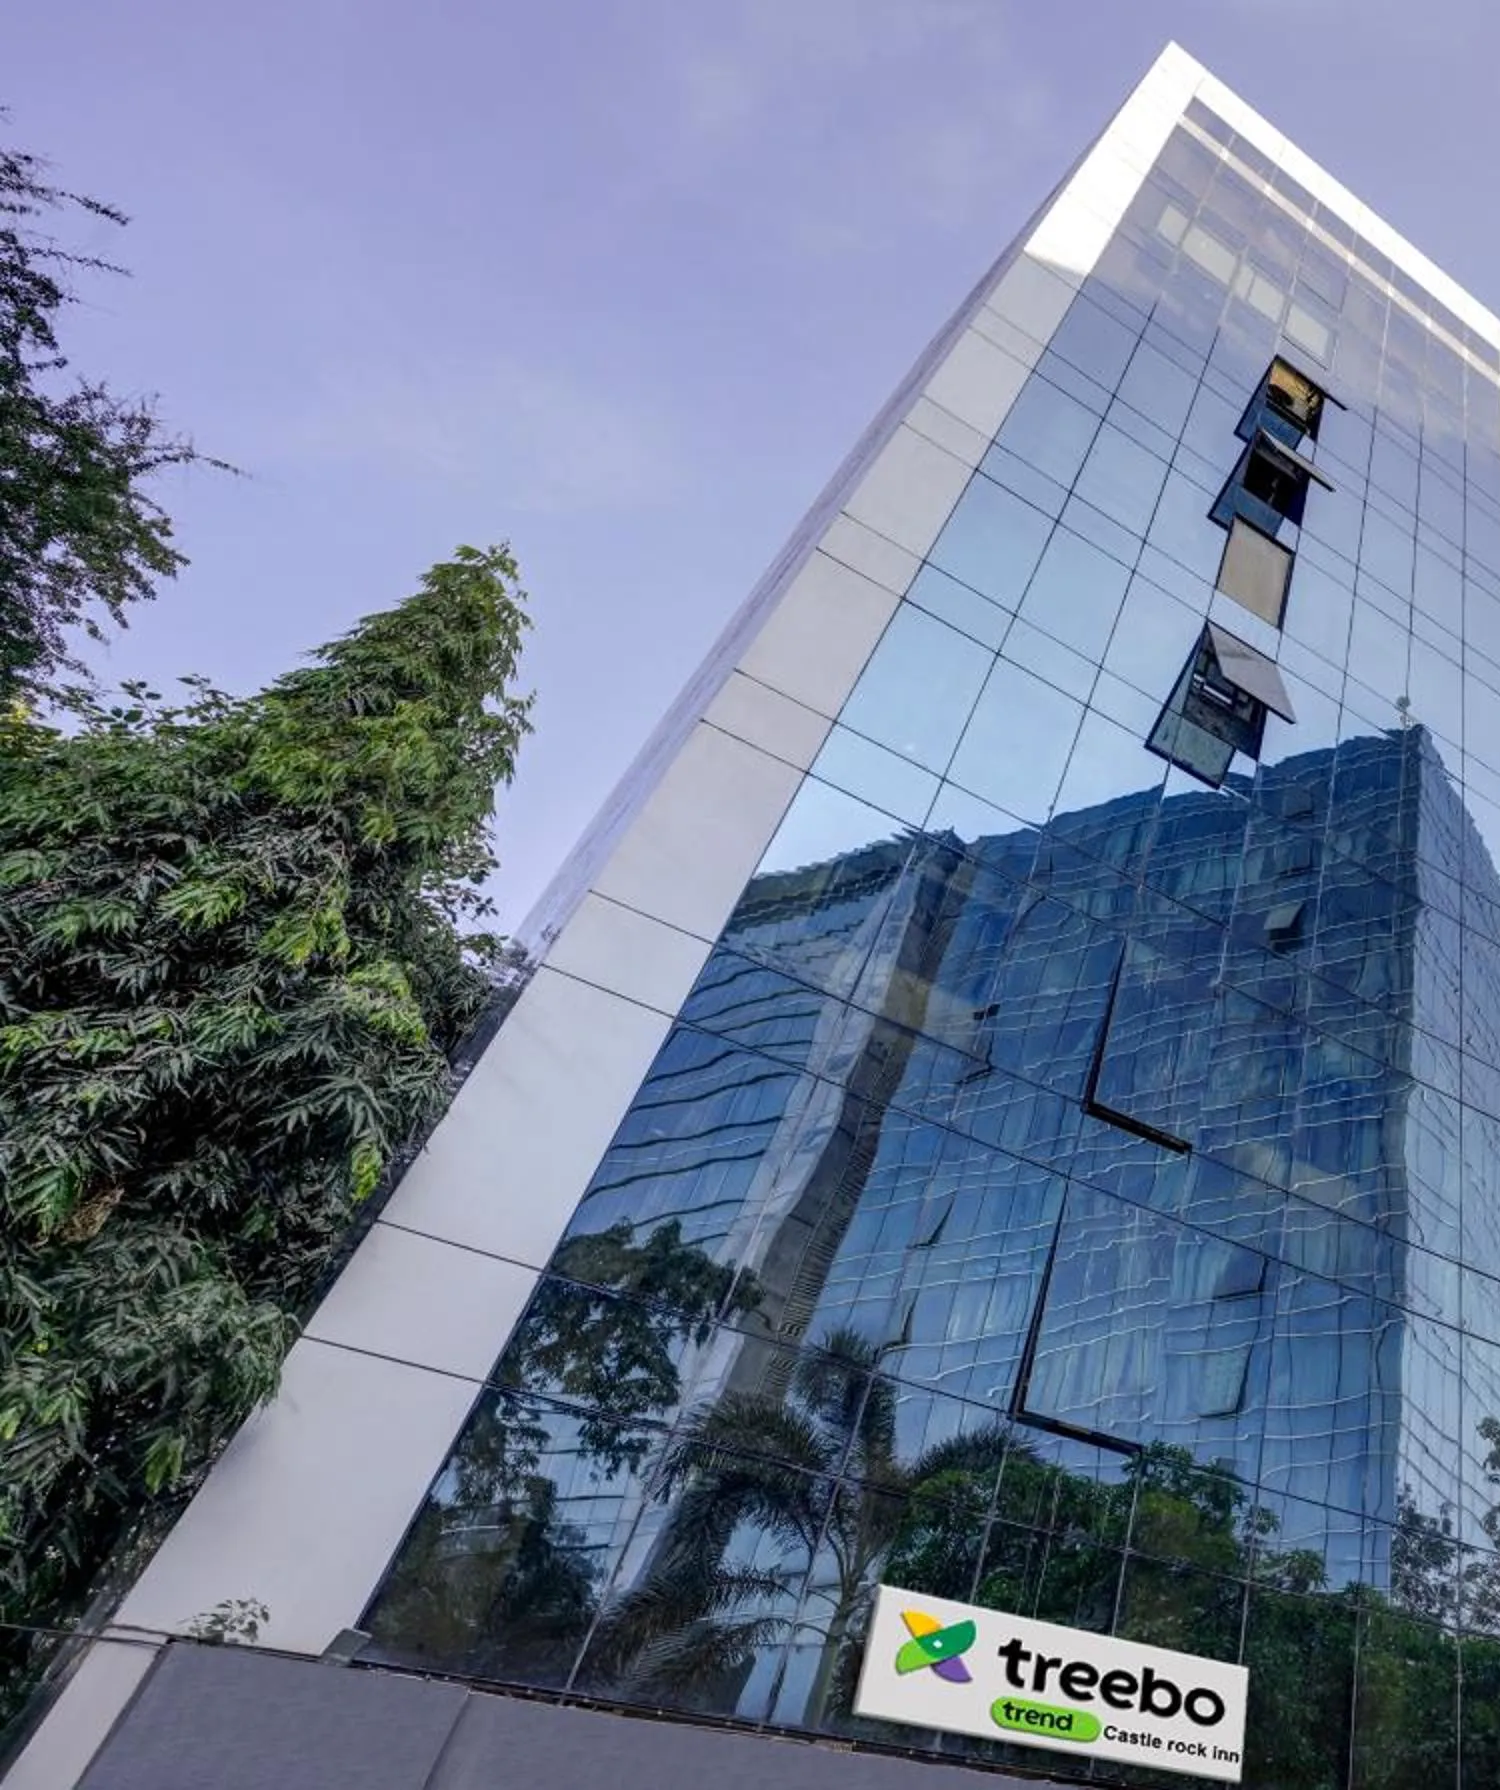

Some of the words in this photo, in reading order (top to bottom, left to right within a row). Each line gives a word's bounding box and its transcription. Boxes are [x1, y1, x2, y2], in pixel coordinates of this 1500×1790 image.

[998, 1638, 1225, 1727] treebo
[1002, 1700, 1074, 1732] trend
[1103, 1725, 1162, 1750] Castle
[1167, 1738, 1207, 1759] rock
[1212, 1747, 1240, 1763] inn
